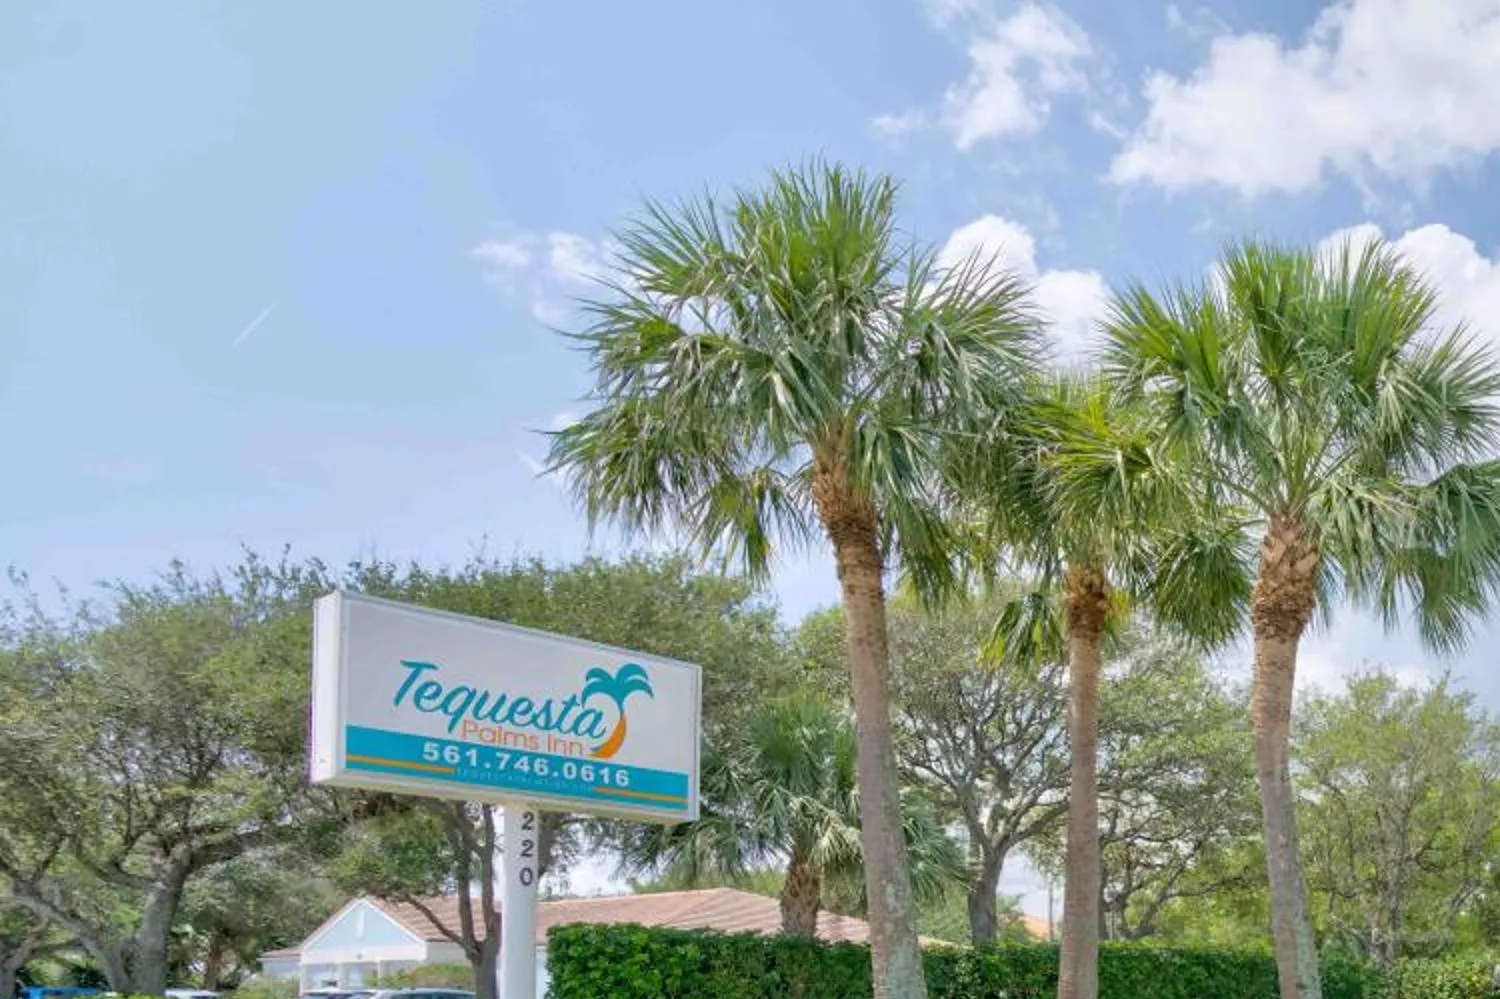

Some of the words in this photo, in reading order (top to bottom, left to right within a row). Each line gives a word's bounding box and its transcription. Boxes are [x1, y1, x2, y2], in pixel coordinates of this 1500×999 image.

[394, 659, 607, 738] Tequesta
[422, 741, 629, 787] 561.746.0616
[462, 719, 540, 750] Palms
[547, 733, 584, 757] Inn
[519, 811, 535, 887] 220
